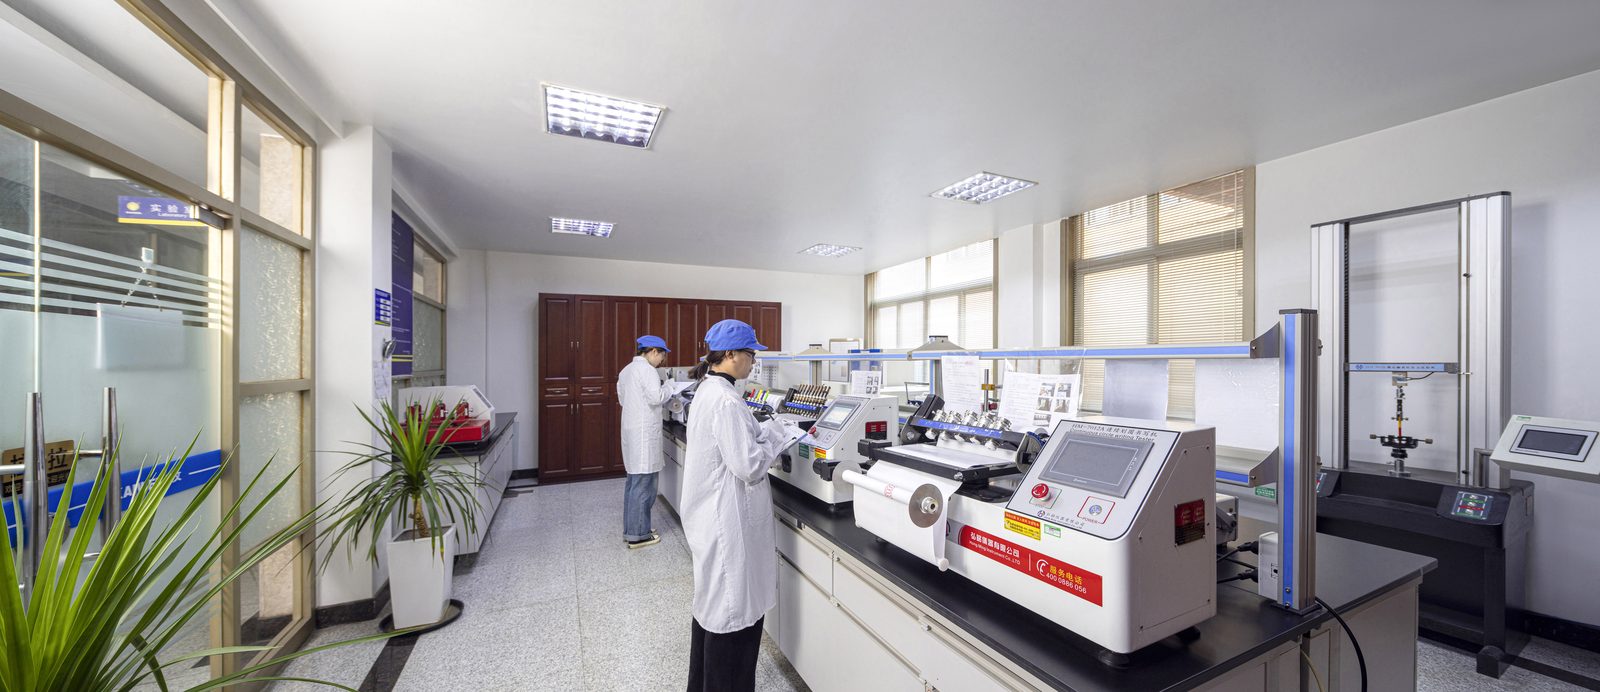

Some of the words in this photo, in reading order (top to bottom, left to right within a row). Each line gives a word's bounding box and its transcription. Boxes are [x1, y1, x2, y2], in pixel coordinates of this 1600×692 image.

[1046, 573, 1057, 582] 400
[1057, 576, 1074, 589] 0886
[1074, 584, 1087, 594] 056
[1049, 565, 1083, 585] 服务电话
